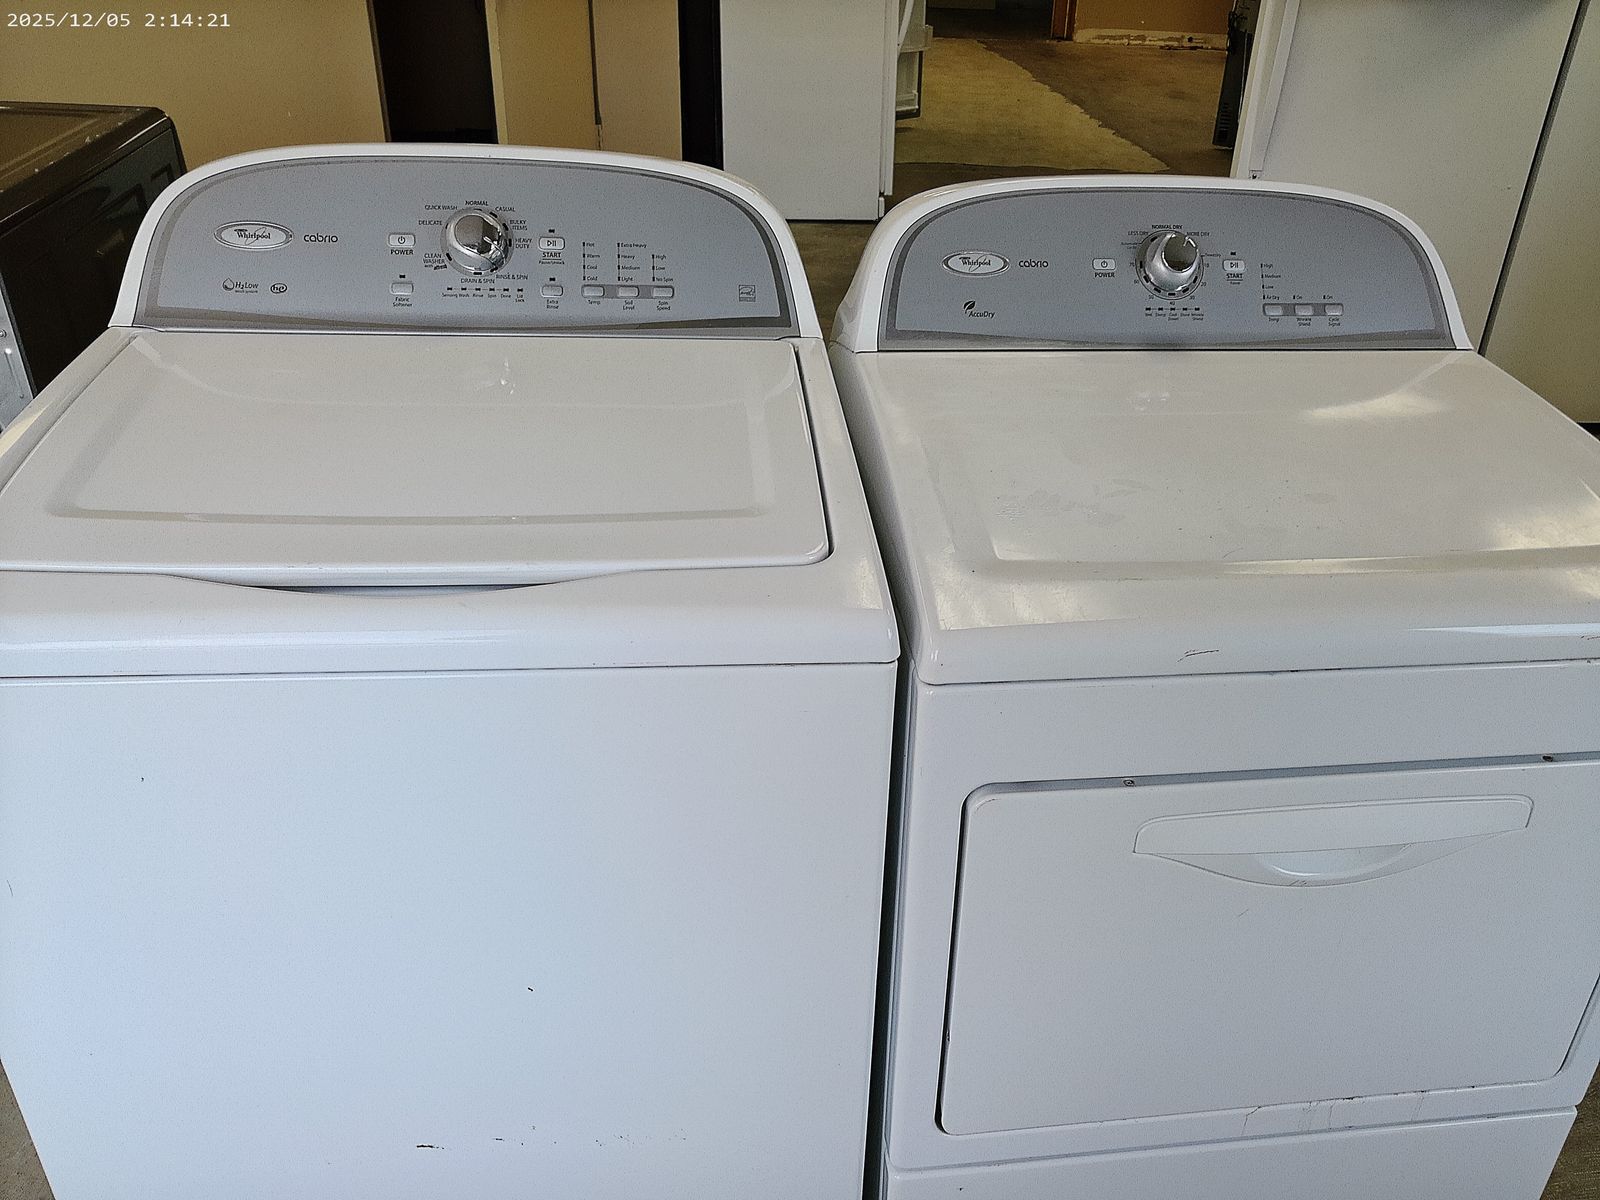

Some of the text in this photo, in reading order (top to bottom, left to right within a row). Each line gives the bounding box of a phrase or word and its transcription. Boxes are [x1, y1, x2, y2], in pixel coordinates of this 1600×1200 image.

[234, 228, 271, 241] Whirlpool
[303, 232, 339, 243] cabrio
[959, 256, 991, 268] Whirlpool
[1018, 258, 1049, 268] cabrio
[517, 273, 529, 281] SPIN
[968, 310, 996, 319] AccuDry
